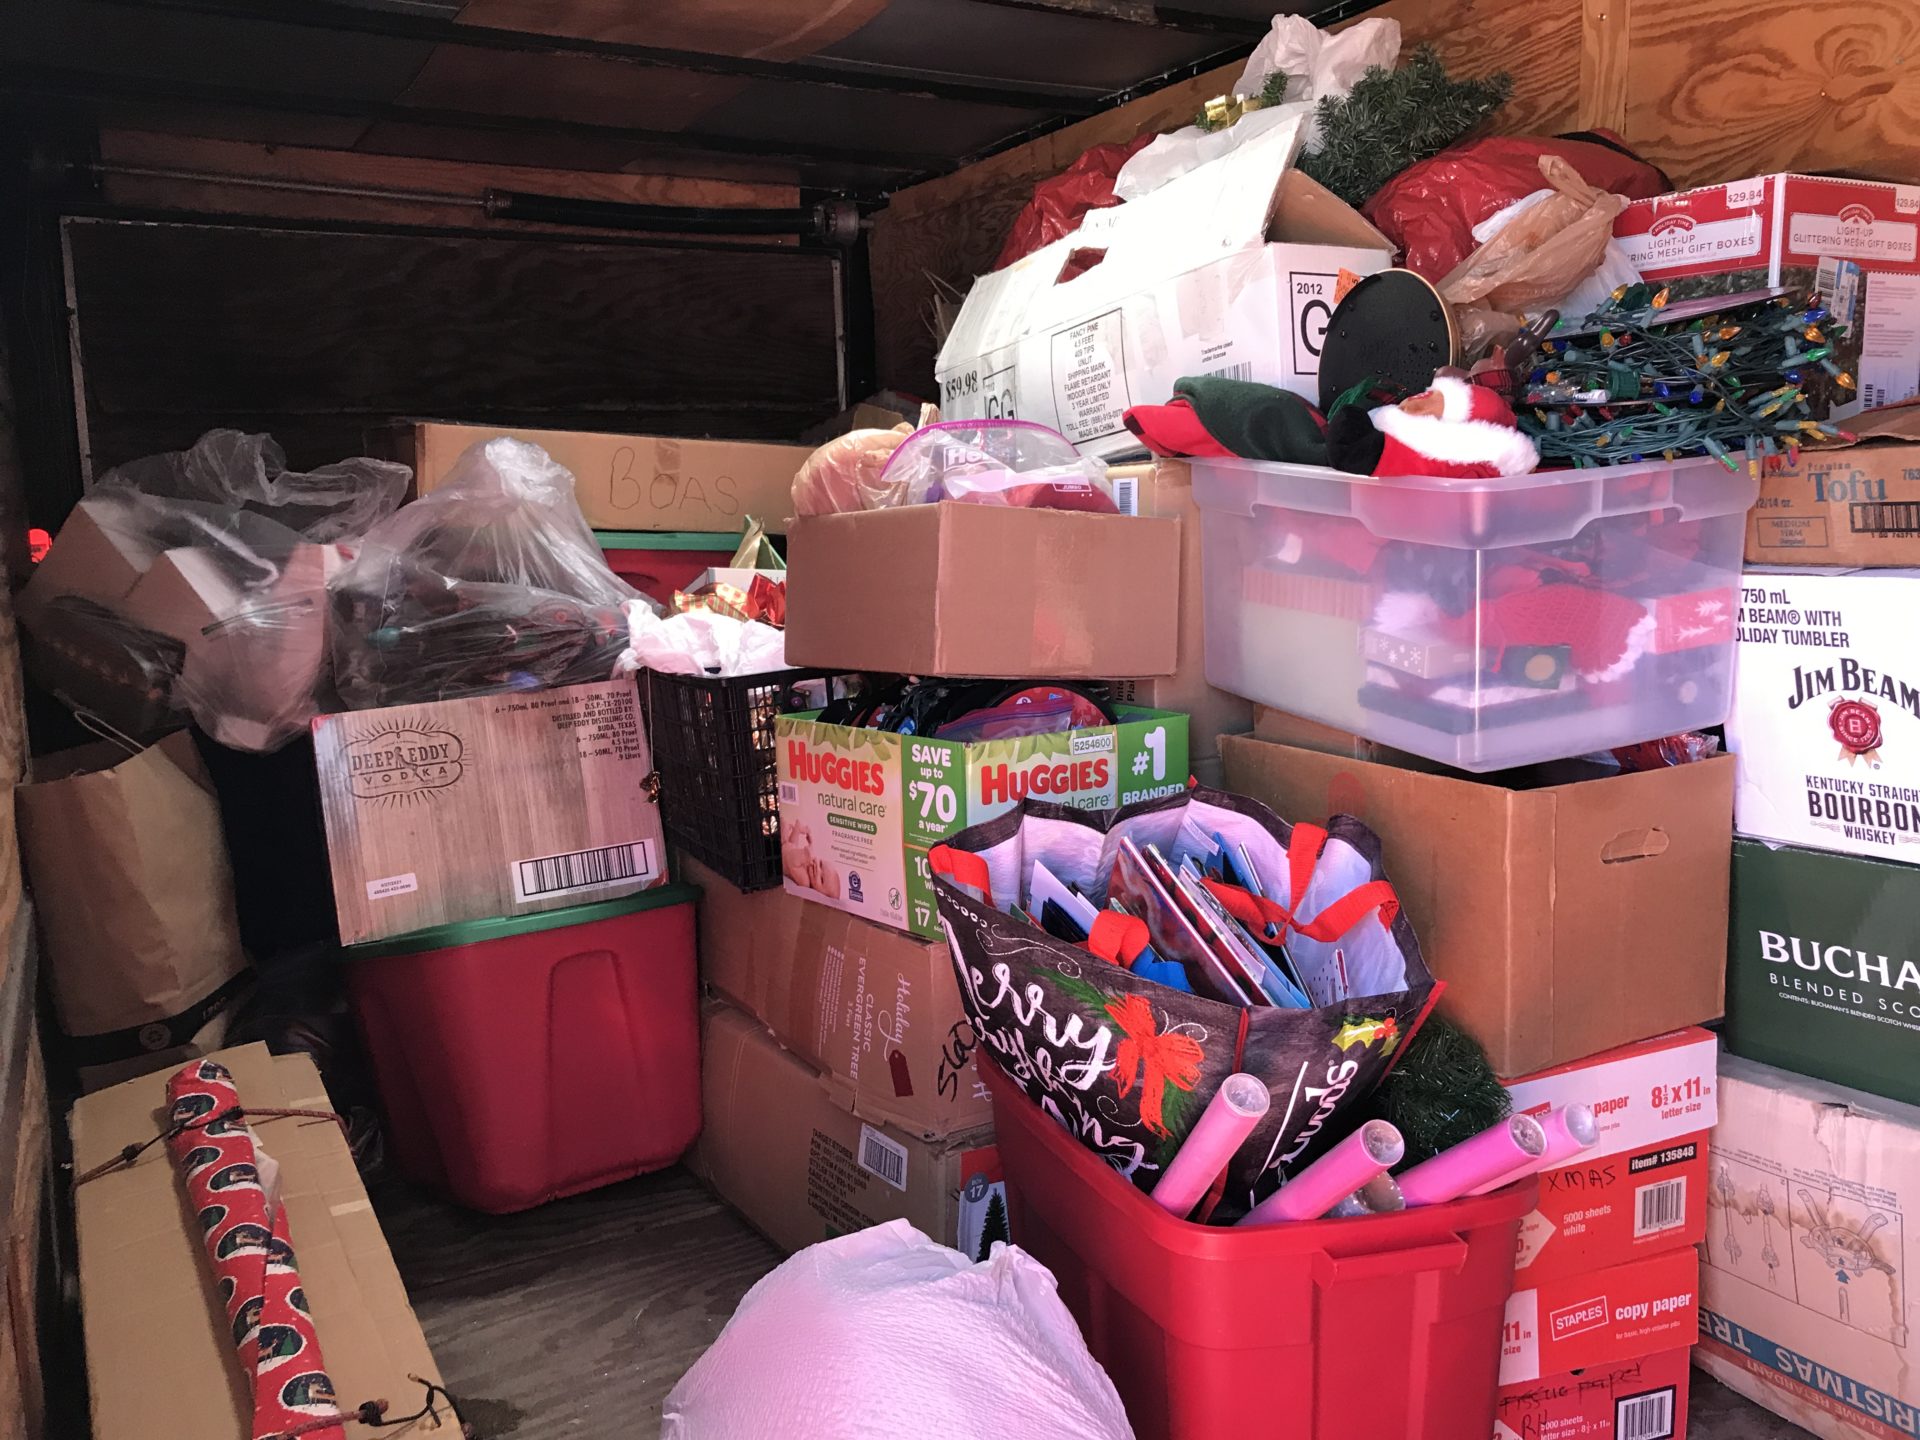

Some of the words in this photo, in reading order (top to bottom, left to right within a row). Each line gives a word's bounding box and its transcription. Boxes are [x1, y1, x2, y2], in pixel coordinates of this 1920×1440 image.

[1728, 189, 1762, 203] $29.84
[1654, 220, 1676, 233] HOLIDAY
[1677, 219, 1690, 228] TIME
[1837, 226, 1873, 236] LIGHT-UP
[1648, 235, 1696, 249] LIGHT-UP
[1658, 246, 1683, 257] MESH
[1689, 243, 1712, 253] GIFT
[1717, 236, 1754, 249] BOXES
[1794, 234, 1840, 245] GLITTERING
[1844, 239, 1864, 247] MESH
[1868, 240, 1884, 248] GIFT
[1887, 241, 1912, 251] BOXES
[1297, 283, 1322, 295] 2012
[1070, 328, 1085, 340] FANCY
[1087, 322, 1099, 333] PINE
[1082, 334, 1094, 345] FEET
[1084, 345, 1094, 355] TIPS
[1078, 356, 1092, 367] UNLIT
[1068, 367, 1089, 381] SHIPPING
[1090, 361, 1105, 374] MARK
[945, 370, 978, 402] $59.98
[1064, 381, 1081, 392] FLAME
[1082, 370, 1111, 387] RETARDANT
[1066, 389, 1085, 401] INDOOR
[1087, 386, 1096, 395] USE
[1097, 381, 1111, 392] ONLY
[1072, 402, 1075, 410] 3
[1076, 398, 1089, 408] YEAR
[1090, 392, 1109, 405] LIMITED
[1079, 403, 1106, 418] WARRANTY
[1066, 422, 1078, 431] TOLL
[1078, 428, 1093, 439] MADE
[1094, 426, 1098, 434] IN
[1100, 422, 1115, 433] CHINA
[609, 446, 739, 515] BOAS
[1808, 470, 1888, 502] Tofu
[1742, 589, 1765, 603] 750
[1770, 589, 1791, 605] mL
[1805, 610, 1842, 627] WITH
[1736, 627, 1778, 643] LIDAY
[1782, 630, 1850, 648] TUMBLER
[1788, 665, 1836, 710] JIM
[1839, 657, 1920, 720] BEAM
[541, 700, 557, 708] Proof
[559, 698, 570, 706] and
[616, 690, 632, 698] Proof
[552, 713, 582, 722] DISTILLED
[598, 708, 623, 717] BOTTLED
[591, 715, 623, 725] DISTILLING
[619, 721, 636, 729] TEXAS
[622, 729, 637, 737] Proof
[623, 737, 638, 745] Liters
[623, 744, 639, 752] Proof
[1075, 738, 1111, 752] 5254600
[352, 751, 393, 770] DEEP
[408, 744, 448, 763] EDDY
[911, 744, 952, 767] SAVE
[1132, 726, 1166, 781] #1
[364, 766, 447, 784] VODKA
[788, 739, 885, 797] HUGGIES
[920, 767, 932, 779] up
[933, 768, 943, 779] to
[980, 758, 1109, 806] HUGGIES
[1806, 774, 1864, 795] KENTUCKY
[909, 780, 957, 823] $70
[1078, 794, 1108, 809] care
[1122, 783, 1184, 805] BRANDED
[817, 792, 857, 812] natural
[859, 802, 885, 818] care
[829, 816, 857, 828] SENSITIVE
[857, 822, 875, 832] WIPES
[832, 830, 859, 844] FRAGRANCE
[861, 837, 873, 846] FREE
[1844, 825, 1896, 845] WHISKEY
[915, 907, 930, 927] 17
[1770, 973, 1863, 1004] BLENDED
[853, 957, 866, 1042] EVERGREEN
[863, 993, 874, 1053] CLASSIC
[878, 973, 912, 1061] Holiday
[850, 1044, 860, 1080] TREE
[1594, 1095, 1630, 1118] paper
[1671, 1085, 1682, 1104] x
[1684, 1076, 1700, 1098] 11
[1703, 1086, 1711, 1095] in
[1661, 1105, 1683, 1120] letter
[1685, 1102, 1702, 1114] size
[1631, 1157, 1657, 1170] item#
[1660, 1145, 1694, 1163] 135848
[1549, 1165, 1616, 1193] XMAS
[970, 1185, 984, 1198] 17
[1563, 1211, 1583, 1225] 5000
[1585, 1204, 1611, 1219] sheets
[1563, 1224, 1586, 1237] white
[1616, 1302, 1648, 1320] copy
[1653, 1293, 1691, 1316] paper
[1556, 1306, 1603, 1331] STAPLES
[1523, 1330, 1531, 1339] in
[1698, 1309, 1751, 1353] TRE
[1504, 1345, 1521, 1355] size
[1745, 1359, 1831, 1409] RETARDANT
[1775, 1347, 1920, 1434] RISTMAS
[1560, 1415, 1584, 1428] sheets
[1834, 1405, 1885, 1436] FLAME
[1561, 1425, 1576, 1436] size
